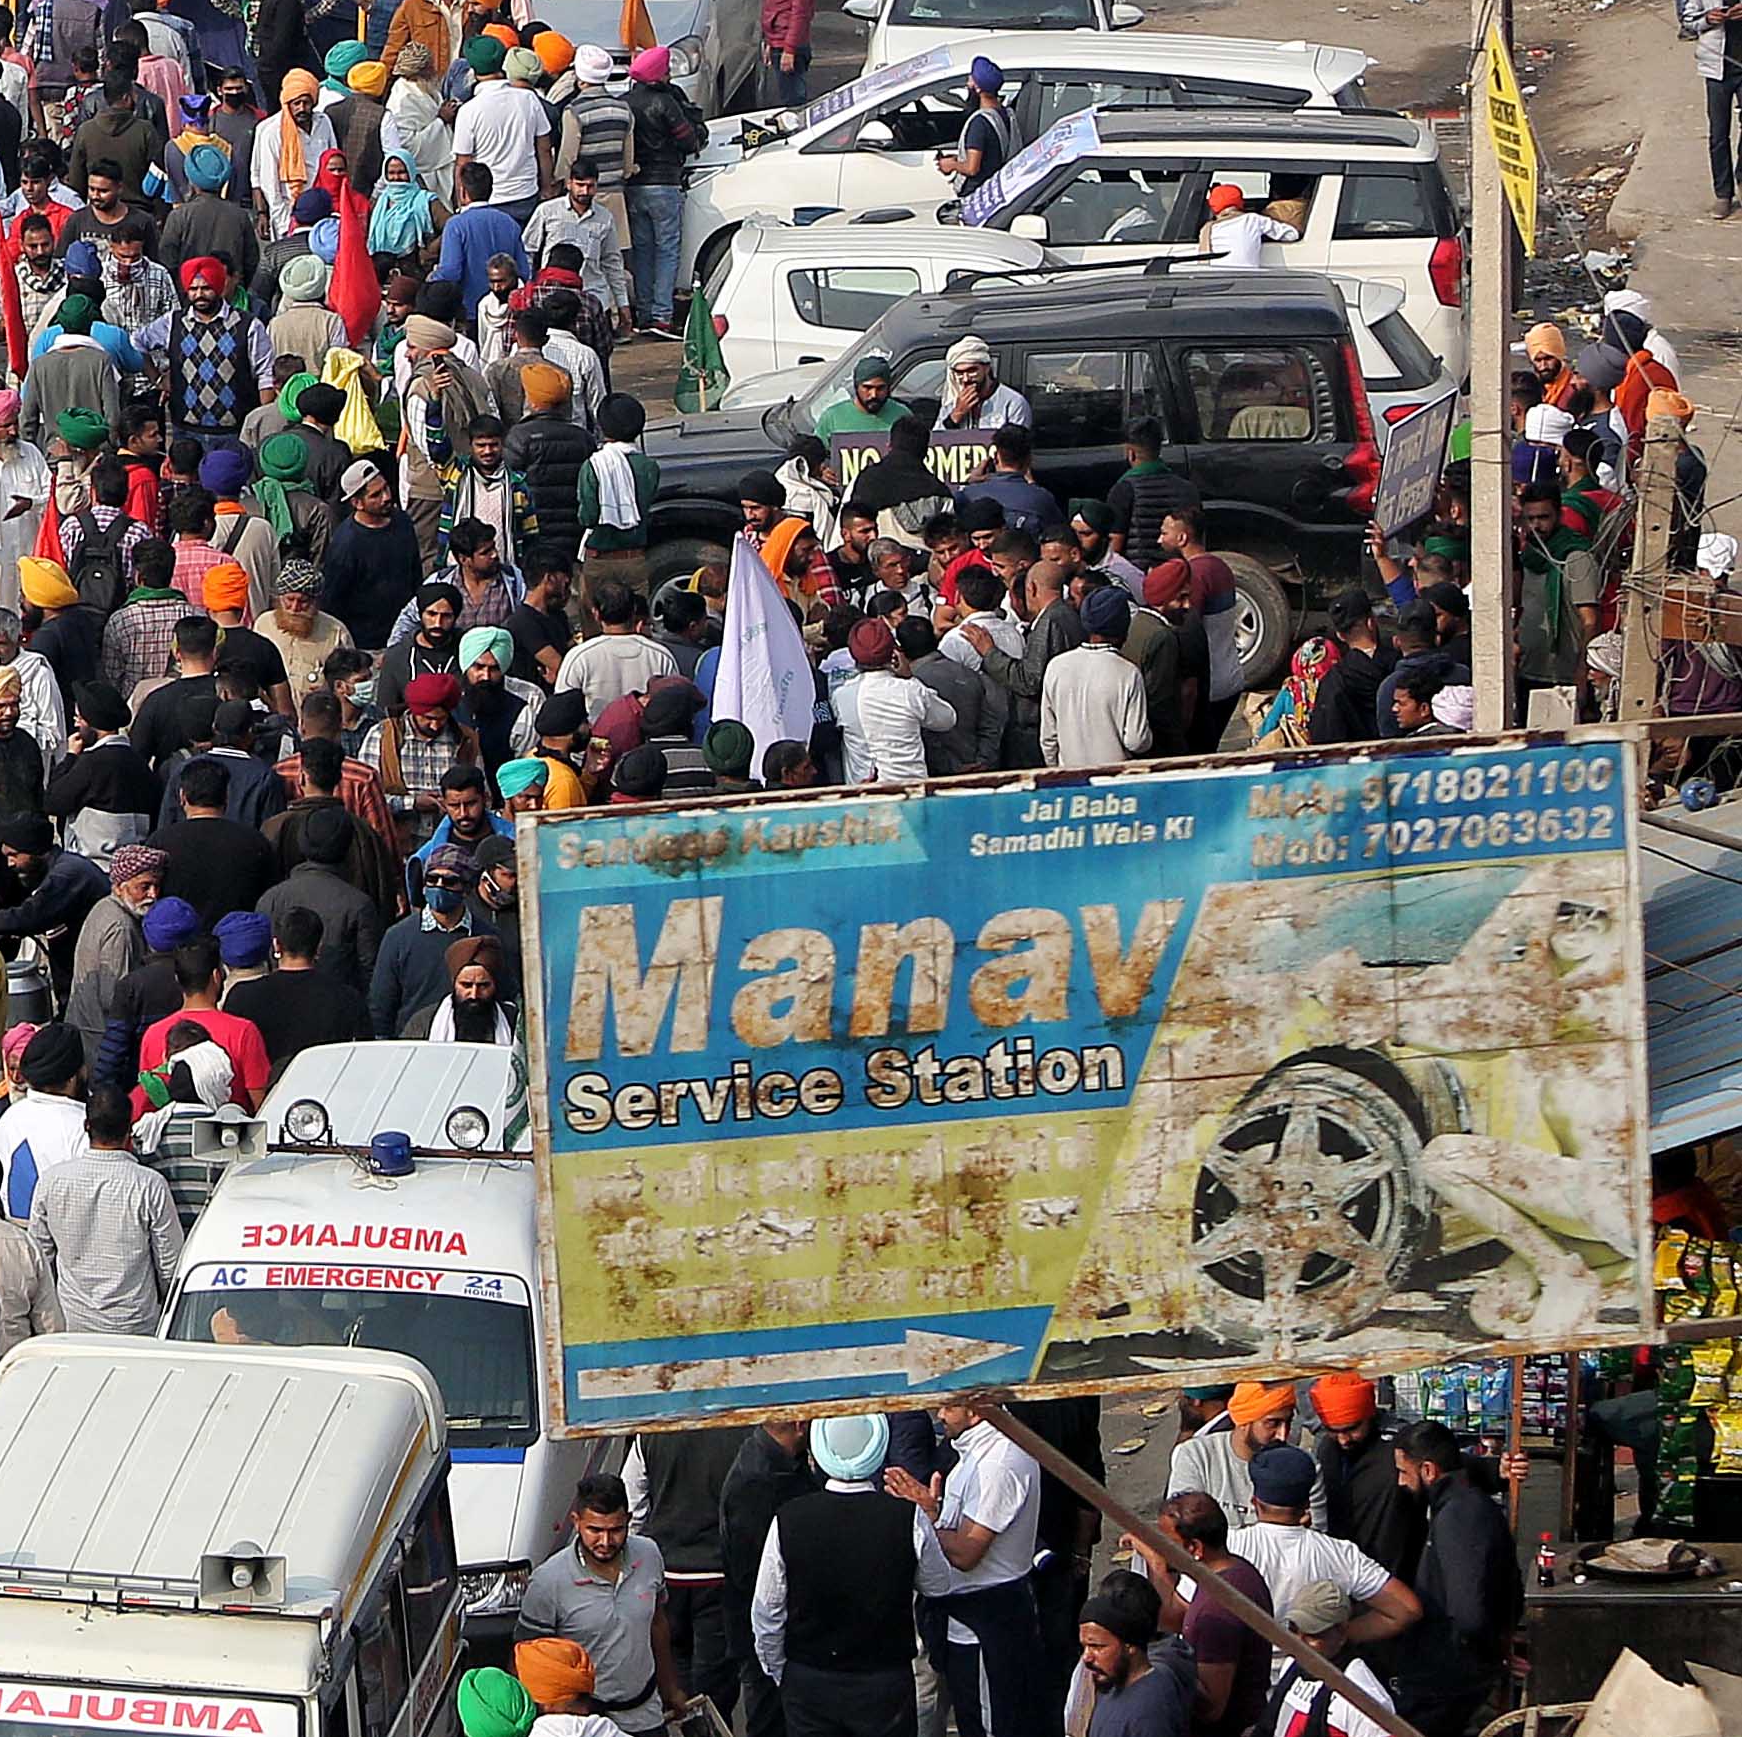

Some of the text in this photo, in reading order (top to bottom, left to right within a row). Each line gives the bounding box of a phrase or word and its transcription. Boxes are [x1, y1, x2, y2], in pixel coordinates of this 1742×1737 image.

[1020, 794, 1138, 825] Jai Baba
[1247, 783, 1347, 821] Mob:
[969, 826, 1086, 858] Samadhi
[1251, 804, 1615, 867] Mob: 7027063632
[564, 893, 1188, 1062] Manav
[563, 1034, 1126, 1134] Service Station
[211, 1266, 504, 1292] AC EMERGENCY 24
[463, 1288, 503, 1300] HOURS
